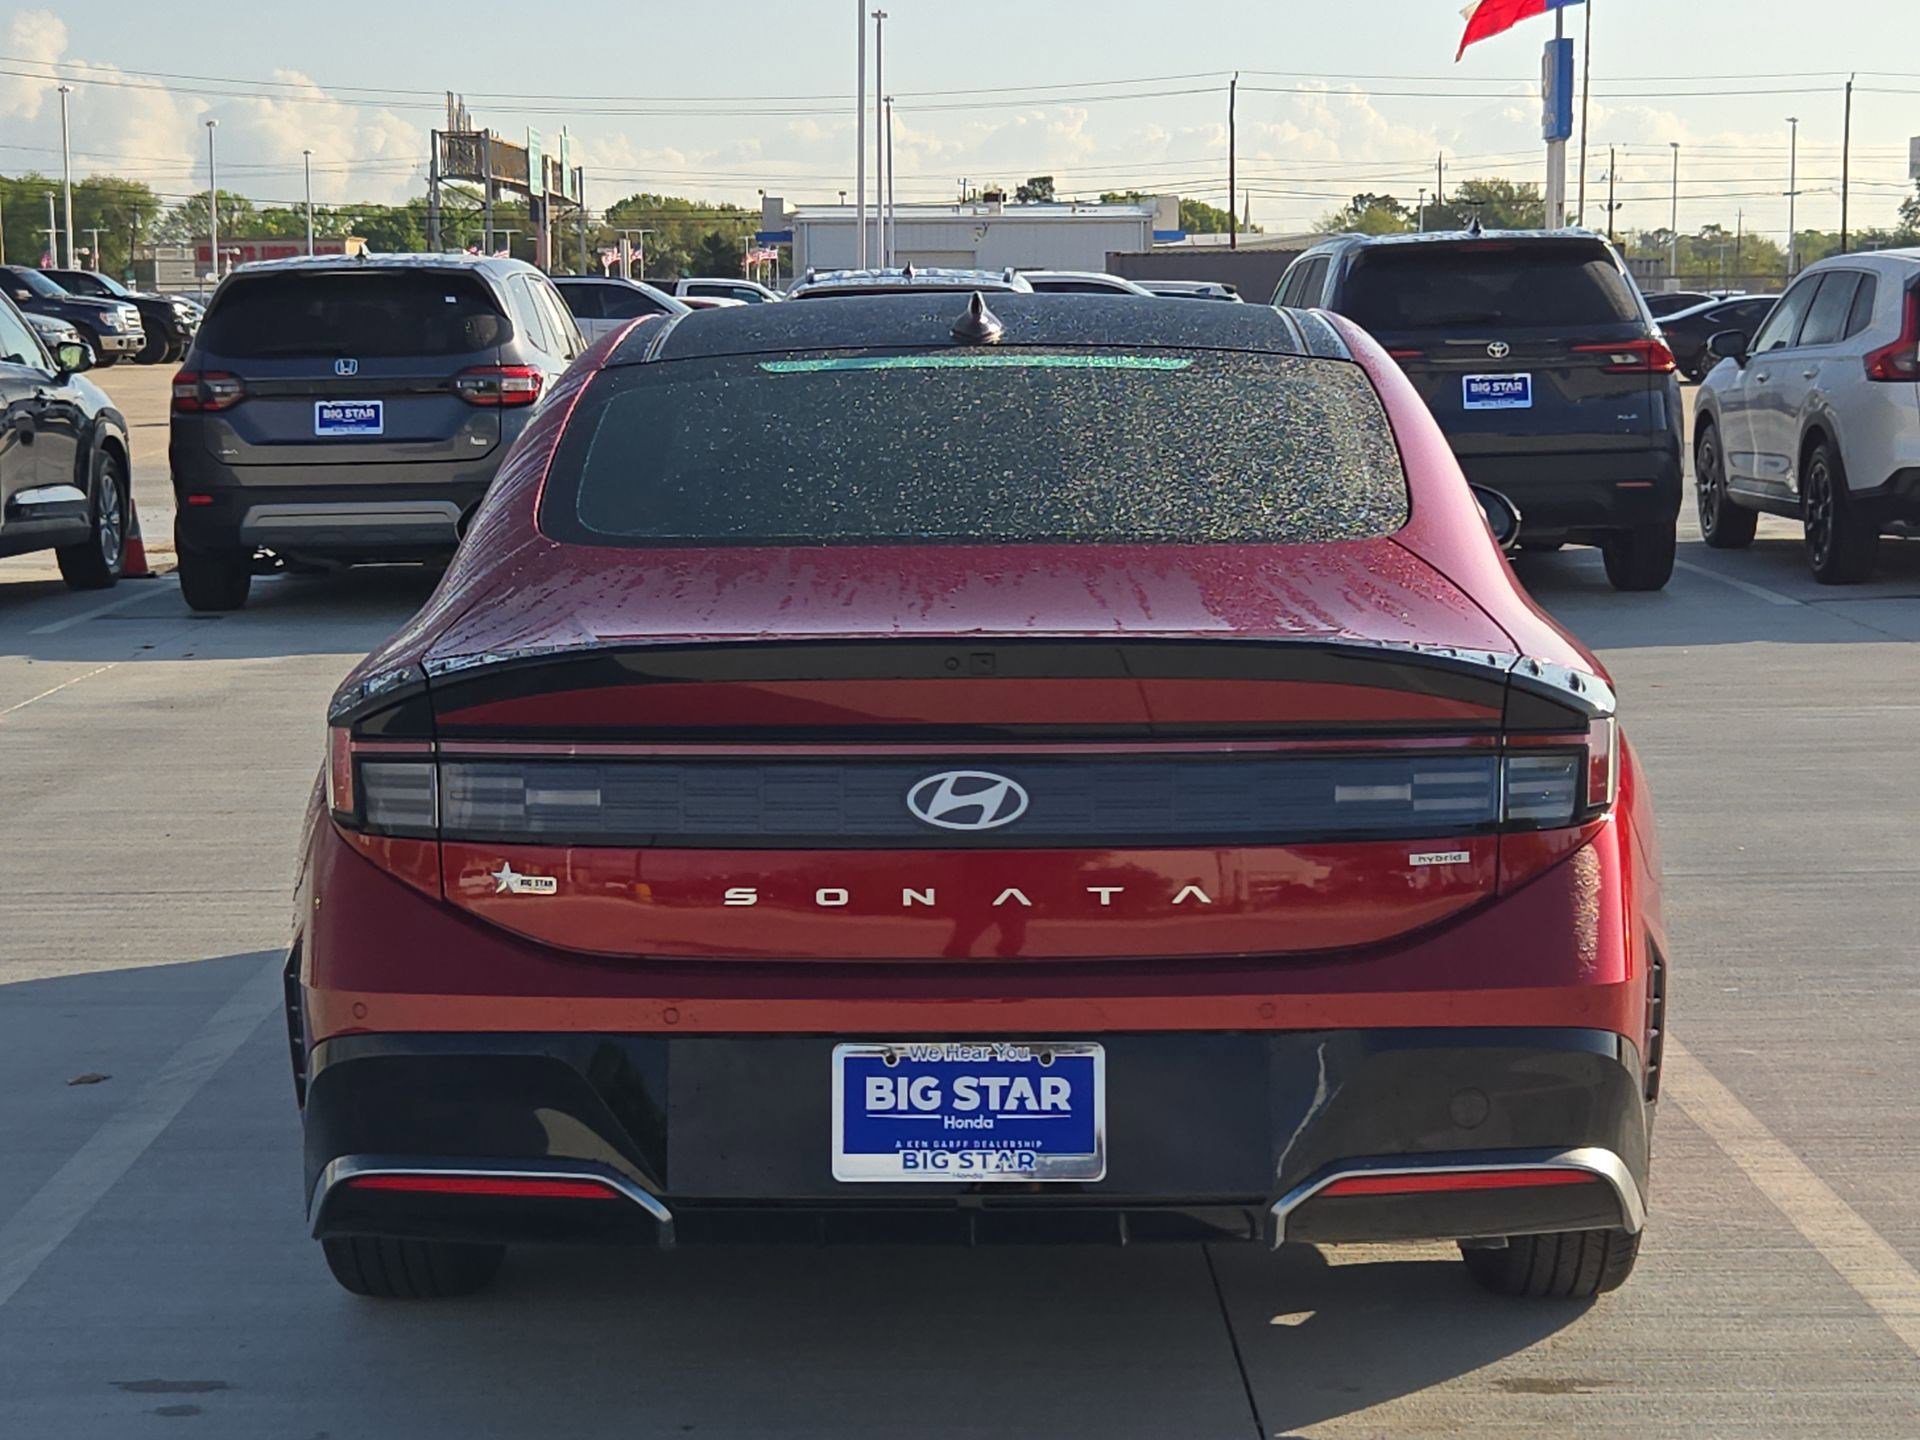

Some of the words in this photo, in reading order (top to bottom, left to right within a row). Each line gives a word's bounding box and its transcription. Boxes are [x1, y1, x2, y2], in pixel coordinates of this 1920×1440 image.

[1471, 382, 1490, 392] BIG
[1492, 382, 1522, 391] STAR
[345, 409, 375, 418] STAR
[1418, 854, 1462, 862] hybrid
[724, 885, 1212, 906] SONATA
[909, 1044, 940, 1060] We
[945, 1043, 990, 1060] Hear
[992, 1043, 1029, 1060] You
[866, 1076, 942, 1111] BIG
[952, 1076, 1072, 1111] STAR
[944, 1114, 994, 1129] Honda
[895, 1140, 903, 1148] A
[906, 1140, 929, 1148] KEN
[973, 1140, 1043, 1148] DEALERSHIP
[902, 1151, 949, 1170] BIG
[958, 1151, 1036, 1170] STAR
